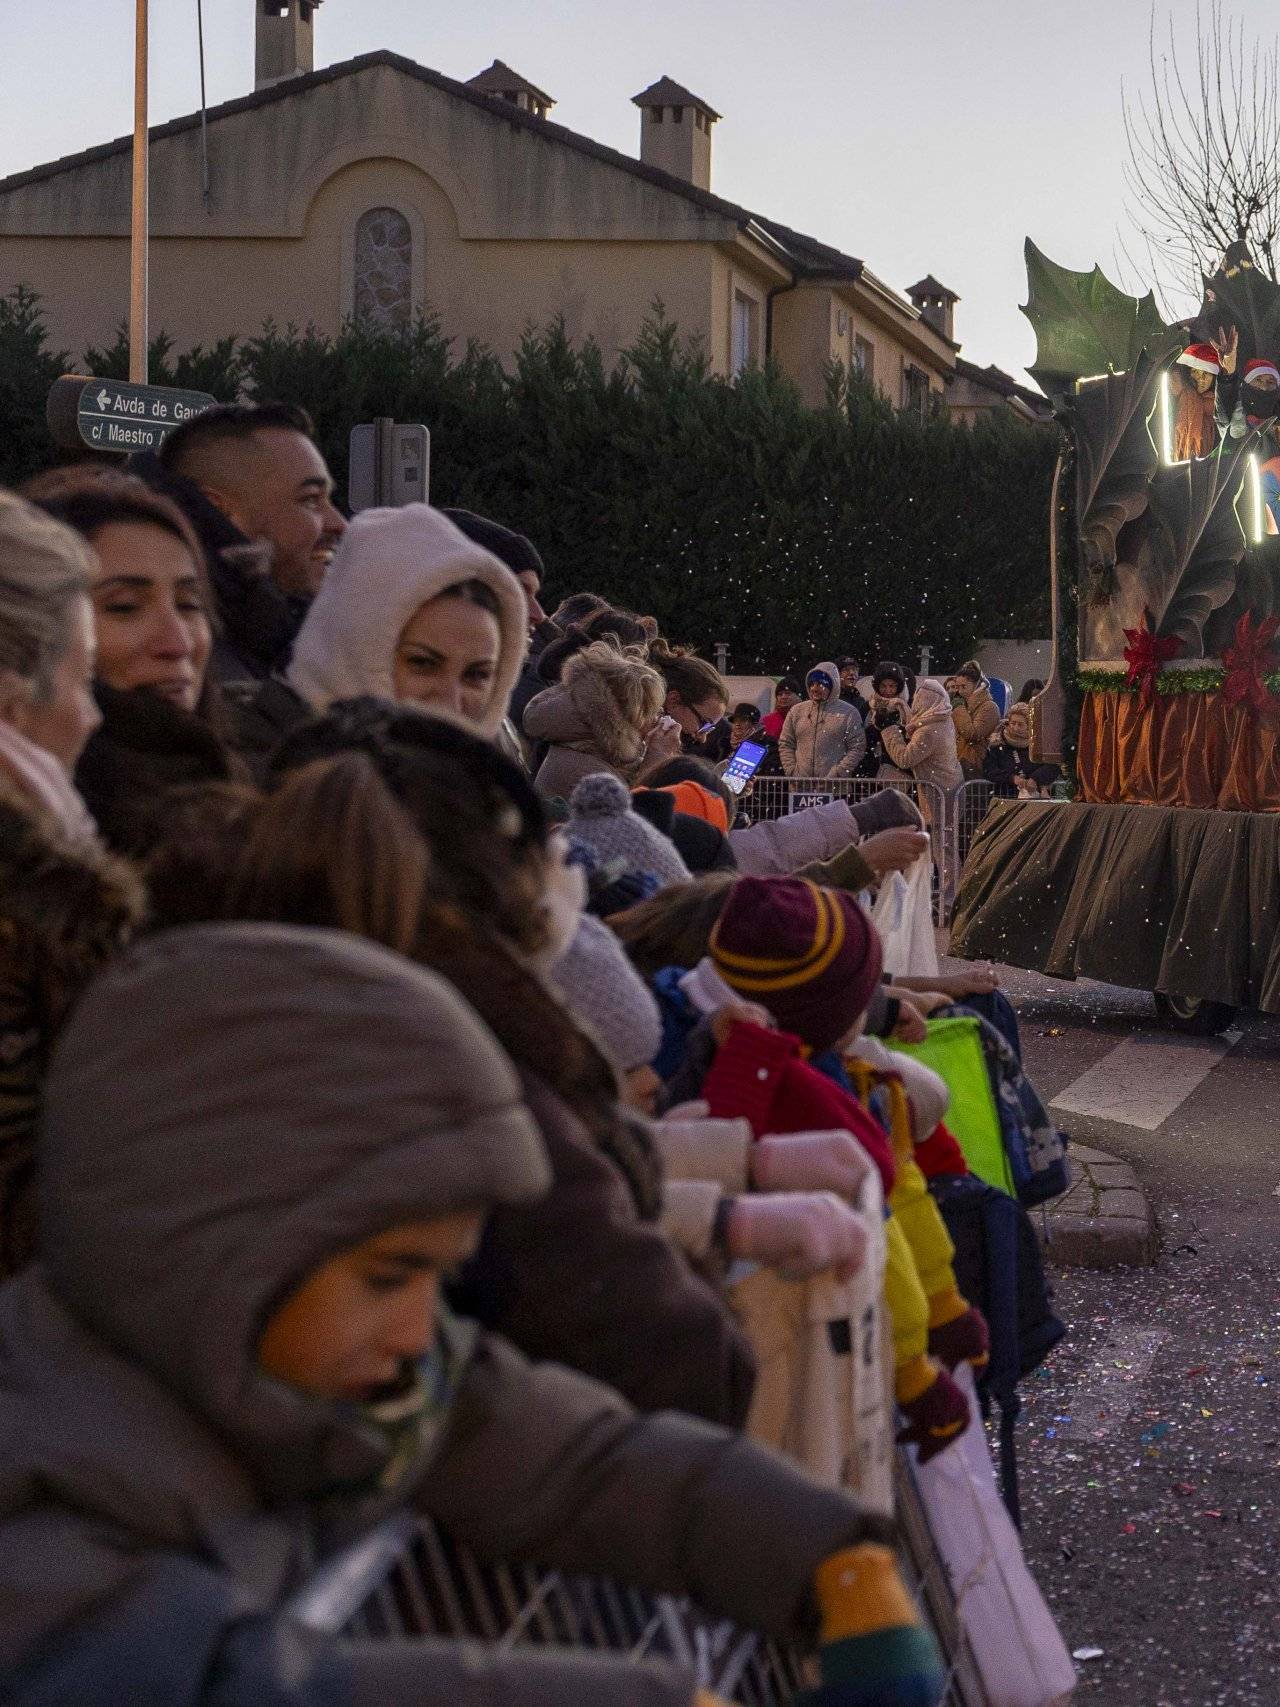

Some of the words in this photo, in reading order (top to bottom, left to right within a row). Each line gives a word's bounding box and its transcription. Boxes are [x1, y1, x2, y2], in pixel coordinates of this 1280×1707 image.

[113, 394, 145, 415] Avda
[152, 400, 167, 417] de
[174, 402, 209, 420] Gau
[92, 422, 104, 440] c/
[109, 423, 153, 445] Maestro
[798, 795, 824, 807] AMS
